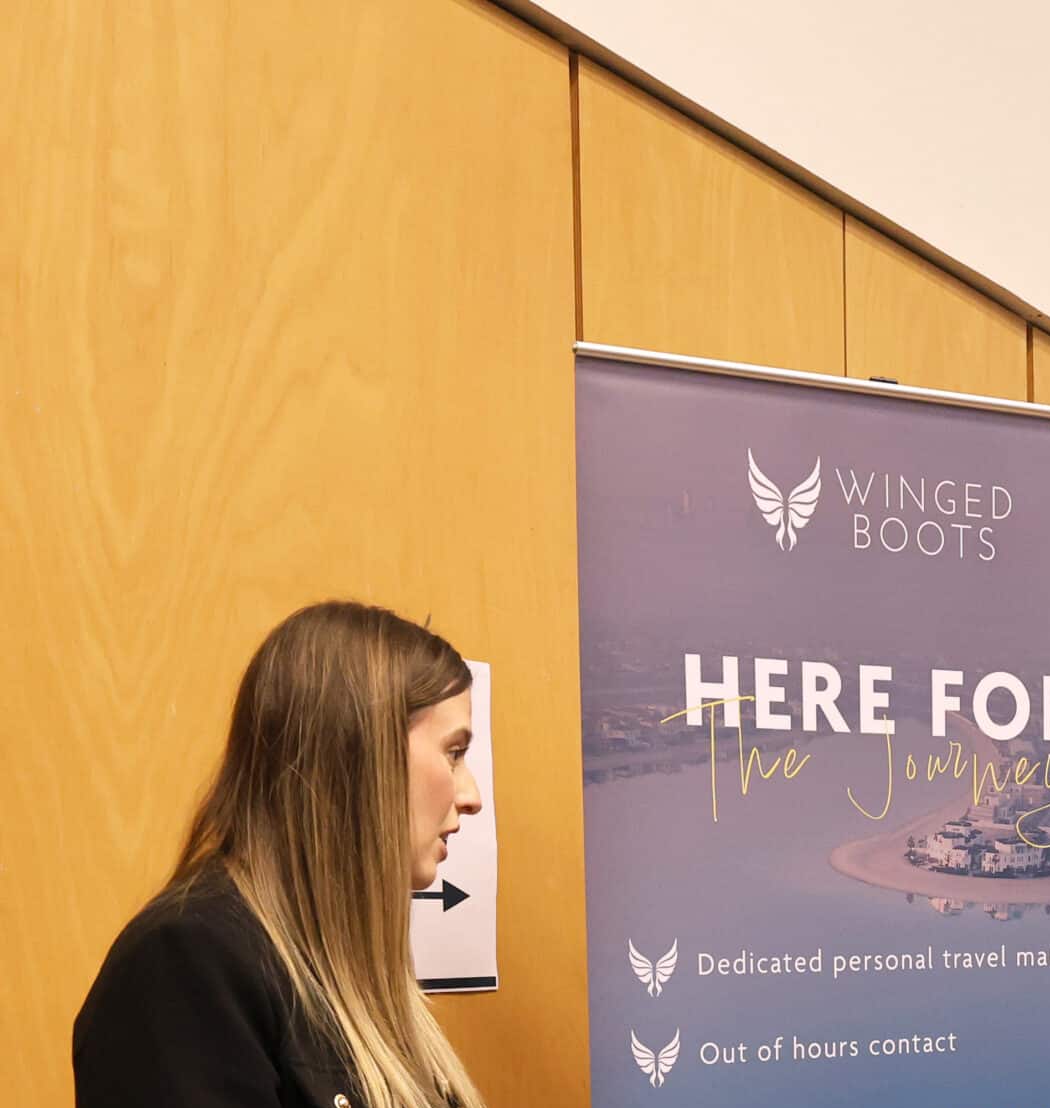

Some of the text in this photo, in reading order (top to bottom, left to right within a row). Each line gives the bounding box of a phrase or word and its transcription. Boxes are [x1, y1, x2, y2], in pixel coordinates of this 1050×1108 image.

[836, 468, 1013, 520] WINGED
[854, 514, 996, 560] BOOTS
[685, 653, 895, 734] HERE
[661, 695, 811, 822] The
[698, 949, 822, 975] Dedicated
[833, 946, 933, 978] personal
[943, 945, 1006, 969] travel
[700, 1032, 957, 1064] Out of hours contact
